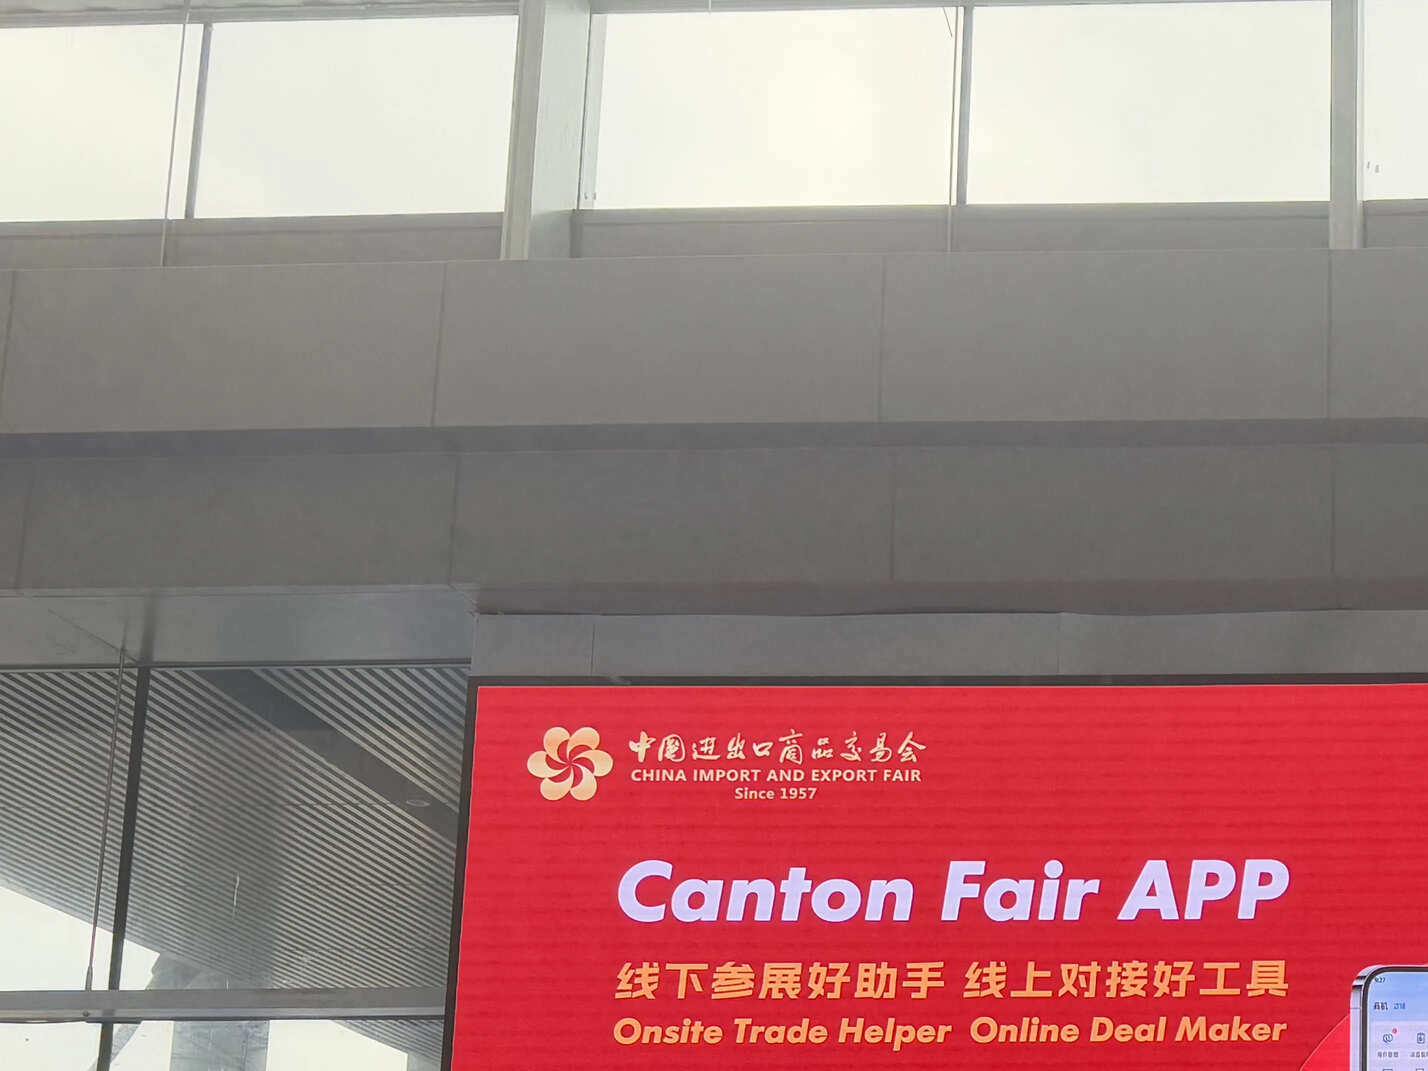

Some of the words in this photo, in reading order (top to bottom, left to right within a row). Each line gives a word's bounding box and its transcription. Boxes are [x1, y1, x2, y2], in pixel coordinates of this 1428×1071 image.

[630, 769, 687, 782] CHINA
[693, 769, 760, 782] IMPORT
[766, 769, 805, 782] AND
[811, 769, 878, 782] EXPORT
[883, 768, 922, 782] FAIR
[734, 787, 775, 800] Since
[780, 787, 817, 800] 1957
[617, 859, 914, 922] Canton
[941, 858, 1099, 922] Fair
[1118, 858, 1290, 920] APP
[616, 961, 945, 1000] 线下参展好助手
[964, 960, 1289, 999] 线上对接好工具
[613, 1017, 723, 1043] Onsite
[732, 1017, 828, 1043] Trade
[837, 1017, 952, 1051] Helper
[969, 1015, 1079, 1042] Online
[1090, 1015, 1166, 1042] Deal
[1175, 1015, 1287, 1042] Maker
